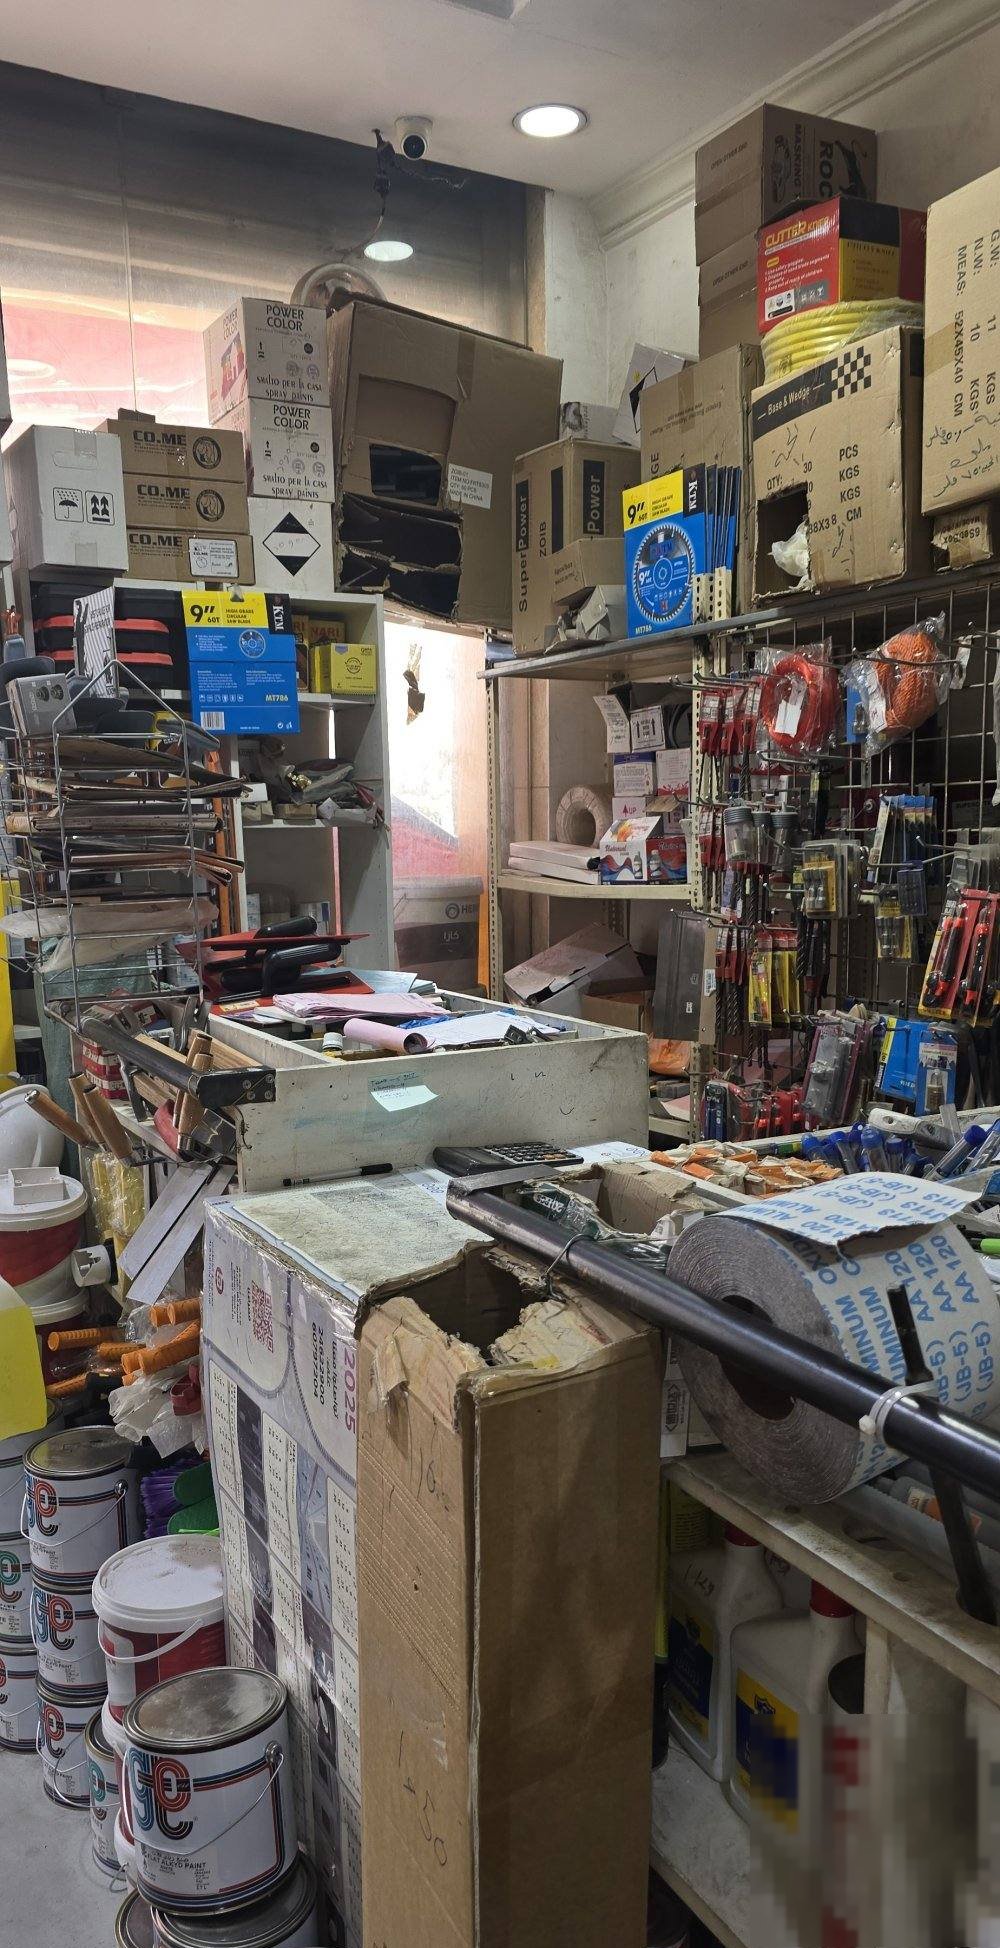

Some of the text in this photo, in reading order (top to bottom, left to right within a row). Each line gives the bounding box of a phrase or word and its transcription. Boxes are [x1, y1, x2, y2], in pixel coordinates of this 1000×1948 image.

[765, 220, 807, 247] CUTTER
[267, 305, 304, 320] POWER
[267, 316, 303, 332] COLOR
[954, 244, 967, 417] MEAS: 52X45X40 CM
[970, 237, 985, 412] N.W: 10 KGS
[987, 314, 997, 332] 11
[986, 371, 996, 405] KGS
[767, 386, 811, 416] Base & Wedge
[273, 404, 311, 419] POWER
[273, 416, 309, 431] COLOR
[133, 430, 187, 446] CO.ME
[766, 444, 859, 491] QTY: 30 PCS
[839, 464, 860, 482] KGS
[137, 484, 191, 499] CO.ME
[688, 480, 698, 511] KTM
[840, 486, 861, 503] KGS
[587, 475, 600, 532] Power
[846, 507, 862, 522] CM
[129, 533, 183, 548] CO.ME
[207, 616, 220, 624] 60T
[273, 605, 284, 631] KTM
[628, 807, 637, 815] UP
[812, 1190, 874, 1209] (JB-5)
[835, 1184, 896, 1202] (JB-5)
[970, 1320, 995, 1393] (JB-5)
[948, 1330, 973, 1402] (JB-5)
[344, 1348, 357, 1436] 2025
